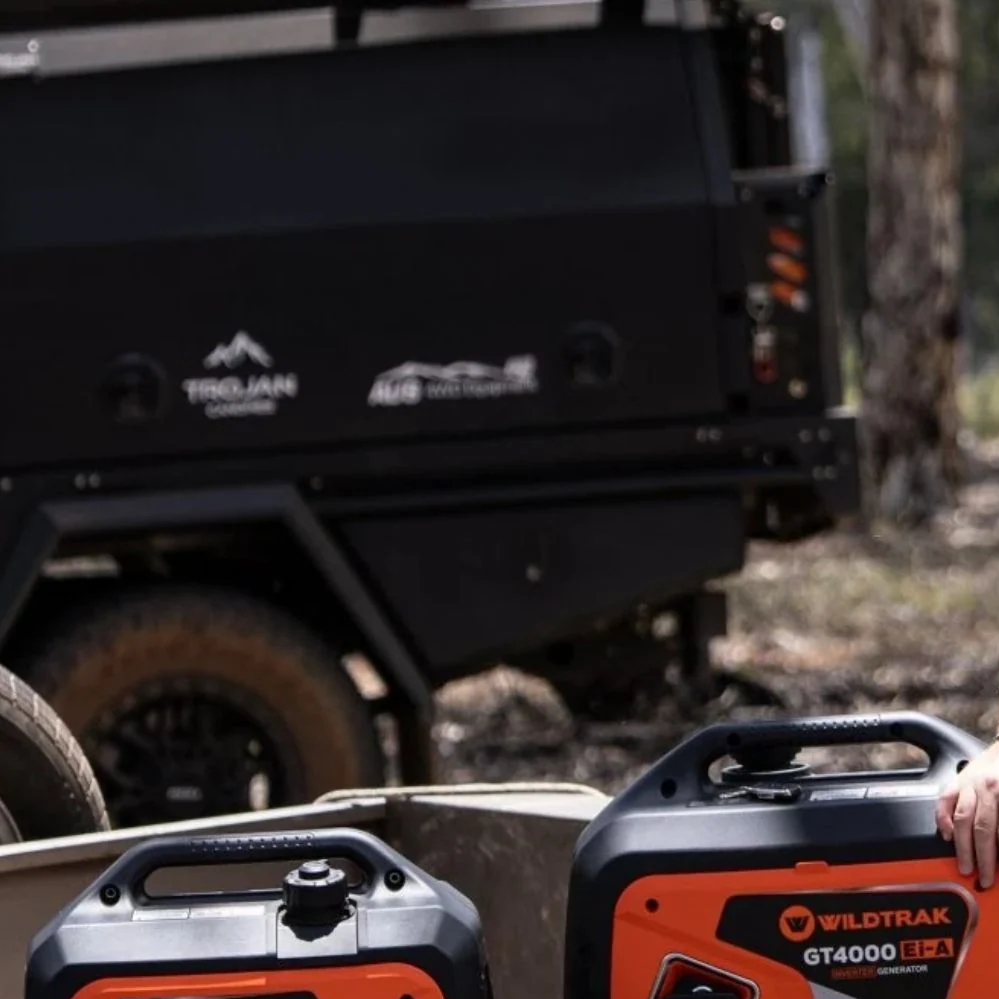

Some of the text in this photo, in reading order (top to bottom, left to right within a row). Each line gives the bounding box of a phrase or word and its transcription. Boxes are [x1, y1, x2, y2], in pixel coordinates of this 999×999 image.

[182, 374, 298, 403] TROJAN
[818, 907, 951, 931] WILDTRAK
[803, 940, 951, 966] GT4000 Ei-A
[877, 965, 928, 975] GENERATOR
